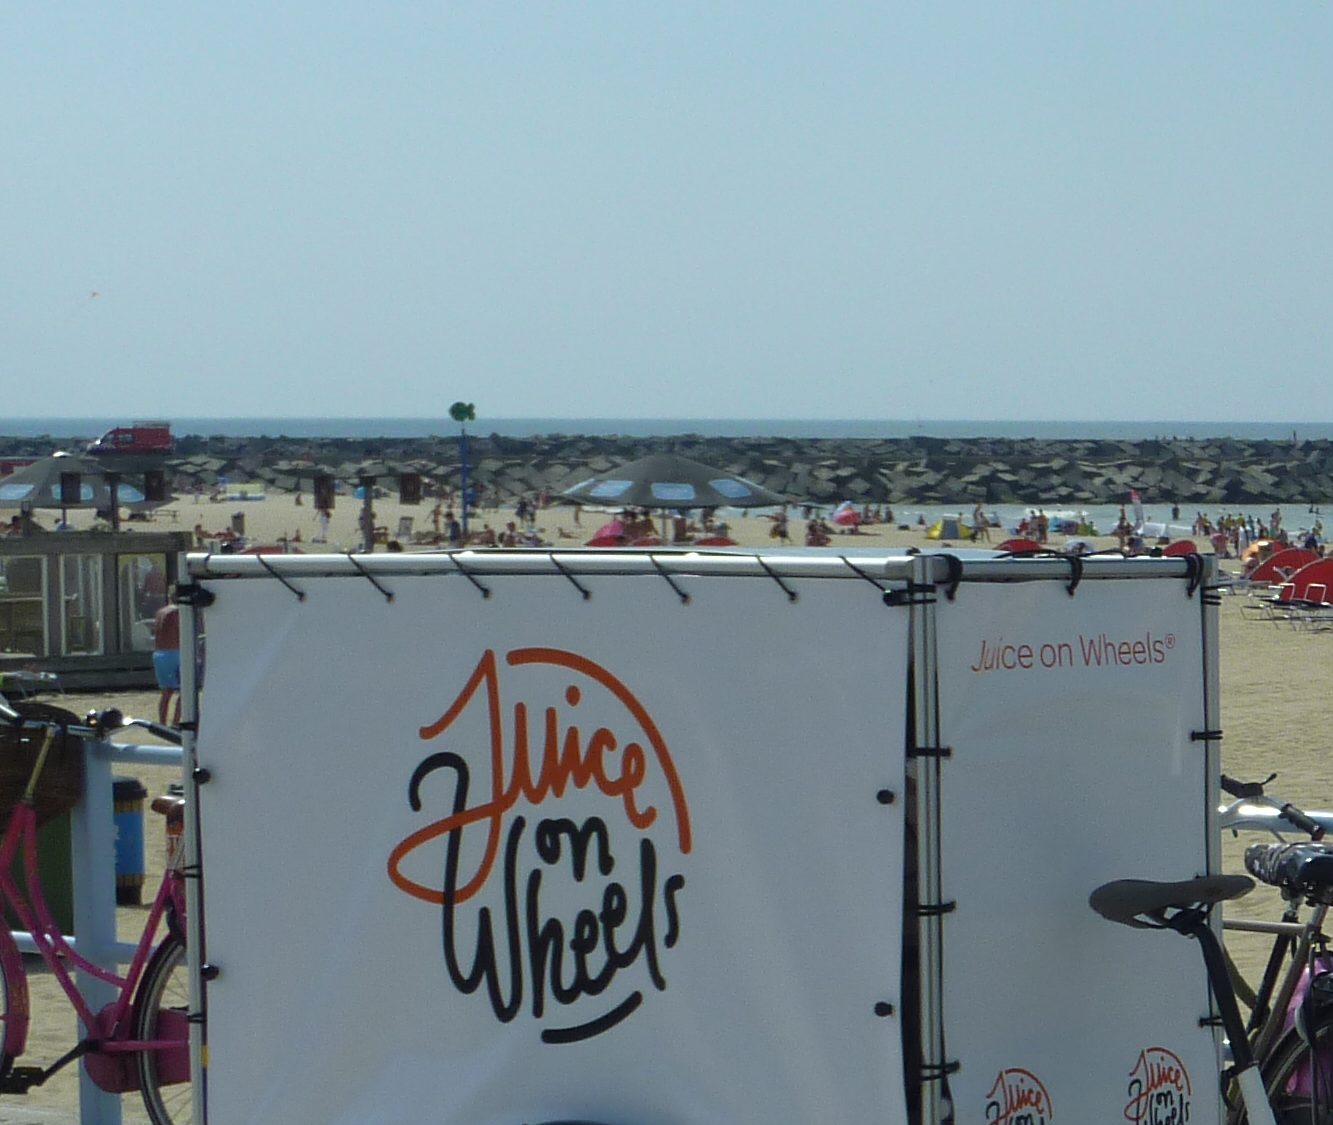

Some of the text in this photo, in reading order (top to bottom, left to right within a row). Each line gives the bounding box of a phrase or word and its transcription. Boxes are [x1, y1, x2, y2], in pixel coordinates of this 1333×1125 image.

[971, 637, 1033, 672] Juice
[1040, 643, 1073, 668] on
[387, 649, 657, 905] Juice
[535, 816, 614, 882] on
[409, 752, 685, 1023] Wheels
[1124, 1050, 1184, 1121] Juice
[1157, 1090, 1174, 1106] on
